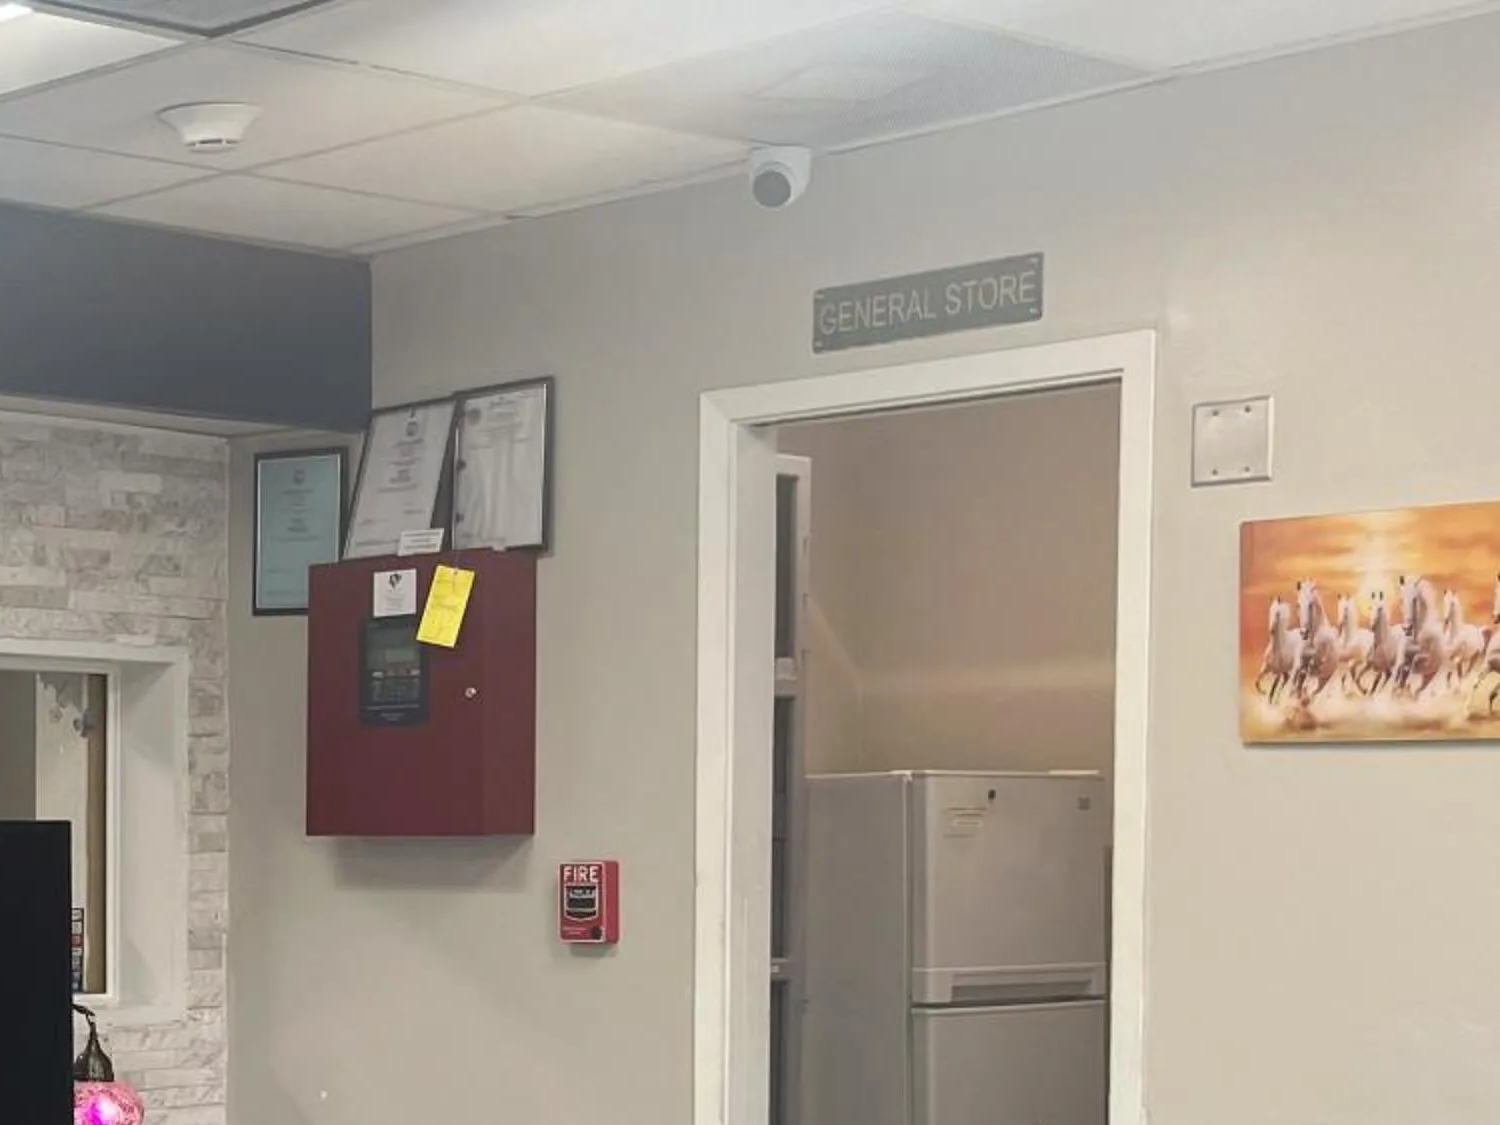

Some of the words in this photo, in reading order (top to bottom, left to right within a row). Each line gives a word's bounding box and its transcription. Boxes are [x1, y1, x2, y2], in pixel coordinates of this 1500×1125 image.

[819, 288, 937, 335] GENERAL
[945, 270, 1037, 315] STORE
[563, 865, 599, 883] FIRE
